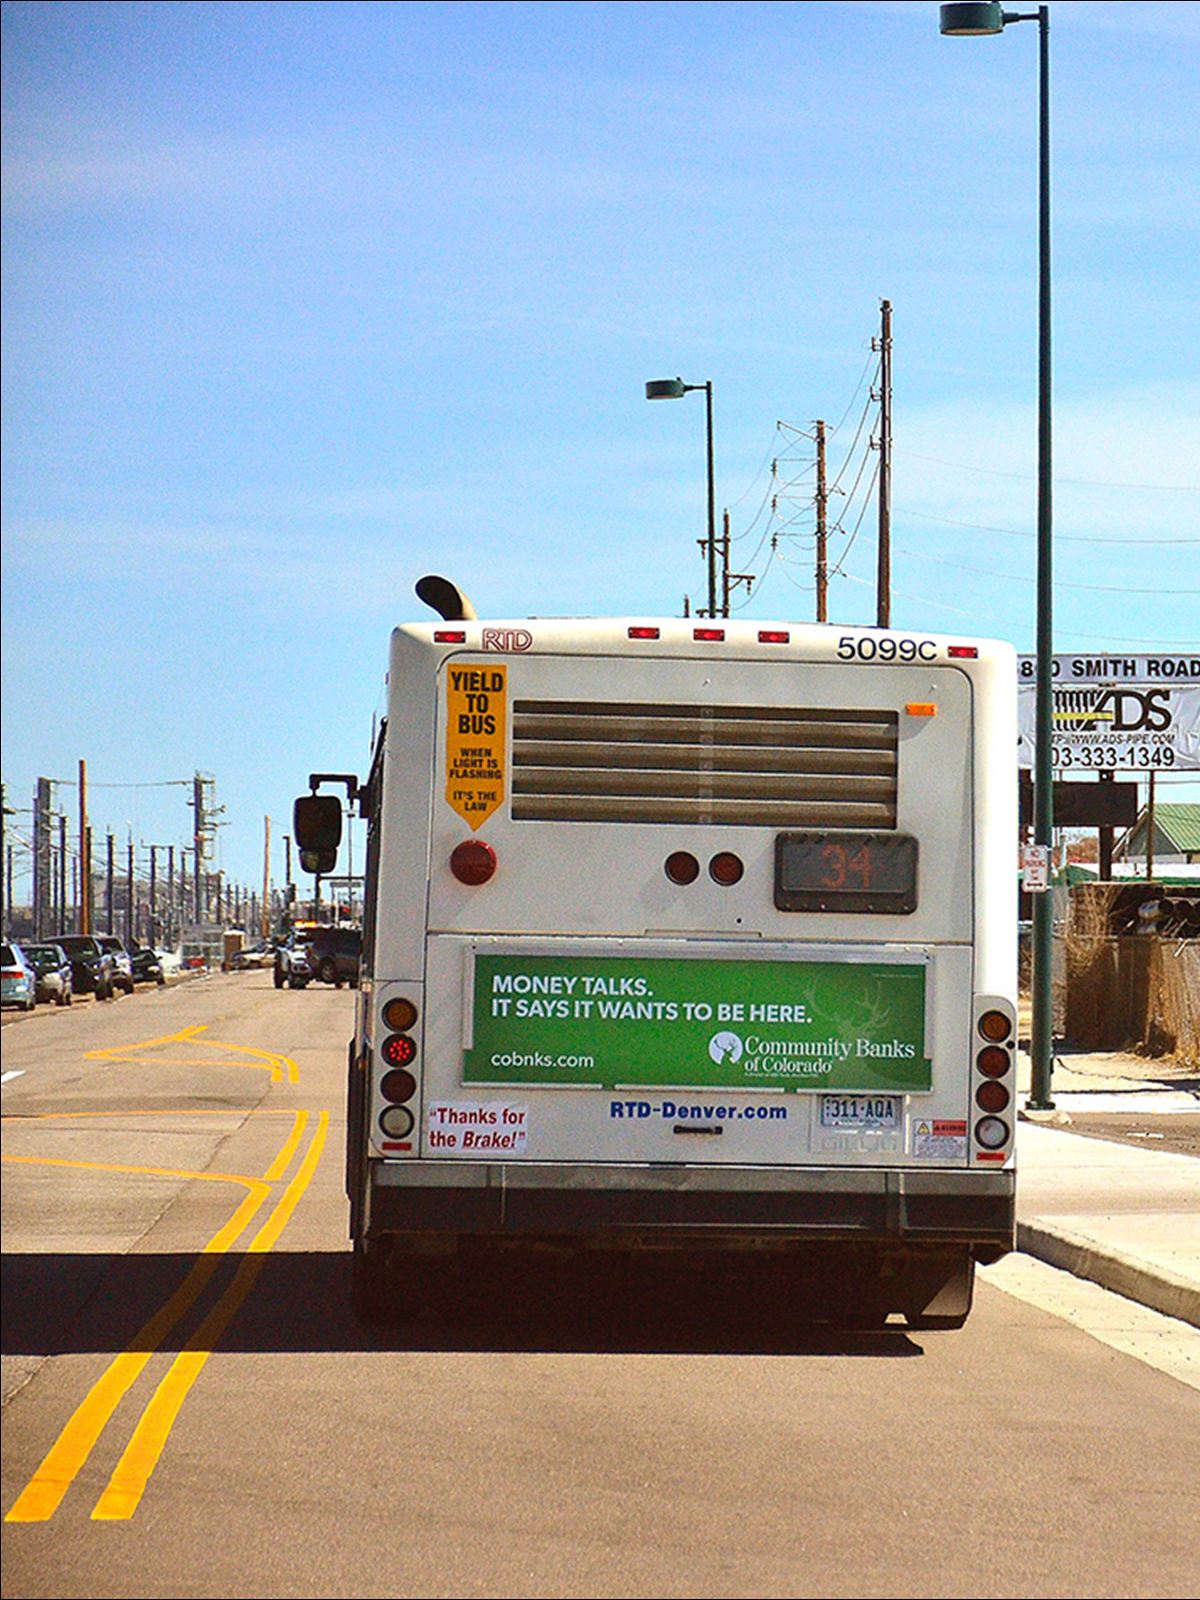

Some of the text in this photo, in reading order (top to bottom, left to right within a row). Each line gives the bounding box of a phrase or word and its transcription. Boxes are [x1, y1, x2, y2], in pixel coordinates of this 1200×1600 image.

[482, 628, 533, 651] RTD
[837, 636, 937, 661] 5099C
[1072, 660, 1136, 678] SMITH
[451, 671, 504, 693] YIELD
[466, 694, 489, 713] TO
[1081, 690, 1172, 732] ADS
[458, 714, 496, 735] BUS
[460, 748, 492, 757] WHEN
[1051, 747, 1175, 767] 03-333-1349
[453, 758, 498, 768] LIGHT IS
[449, 769, 502, 779] FLASHING
[453, 791, 497, 801] IT'S THE
[464, 801, 488, 812] LAW
[821, 844, 872, 889] 34
[492, 975, 653, 997] MONEY TALKS.
[491, 998, 813, 1023] IT SAYS IT WANTS TO BE HERE.
[744, 1035, 915, 1061] Community Banks
[490, 1051, 594, 1068] cobnks.com
[744, 1057, 832, 1074] of Colorado
[502, 1107, 526, 1124] for
[610, 1101, 788, 1120] RTD-Denver.com
[428, 1131, 457, 1148] the
